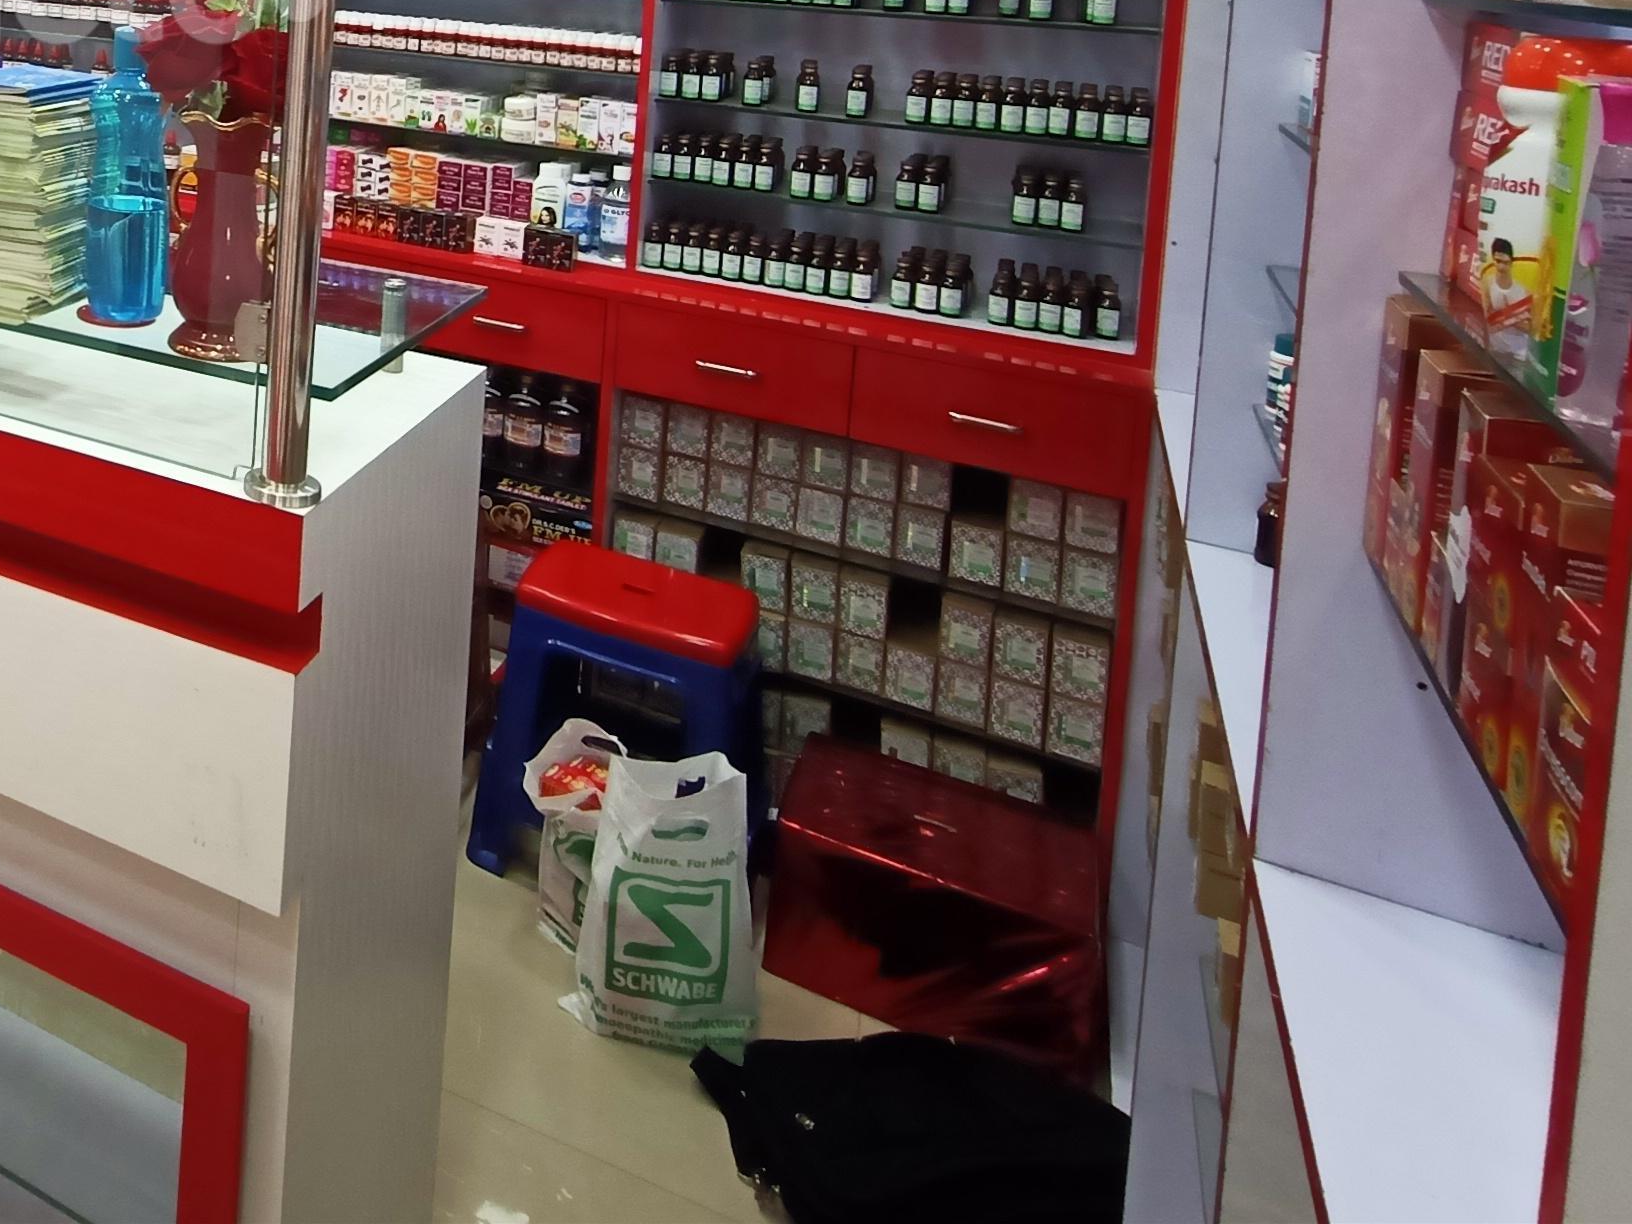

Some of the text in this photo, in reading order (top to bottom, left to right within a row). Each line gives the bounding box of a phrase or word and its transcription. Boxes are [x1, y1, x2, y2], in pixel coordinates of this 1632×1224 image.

[631, 851, 681, 868] Nature.
[687, 858, 707, 868] For
[612, 967, 717, 1000] SCHWABE
[611, 1003, 659, 1025] largest
